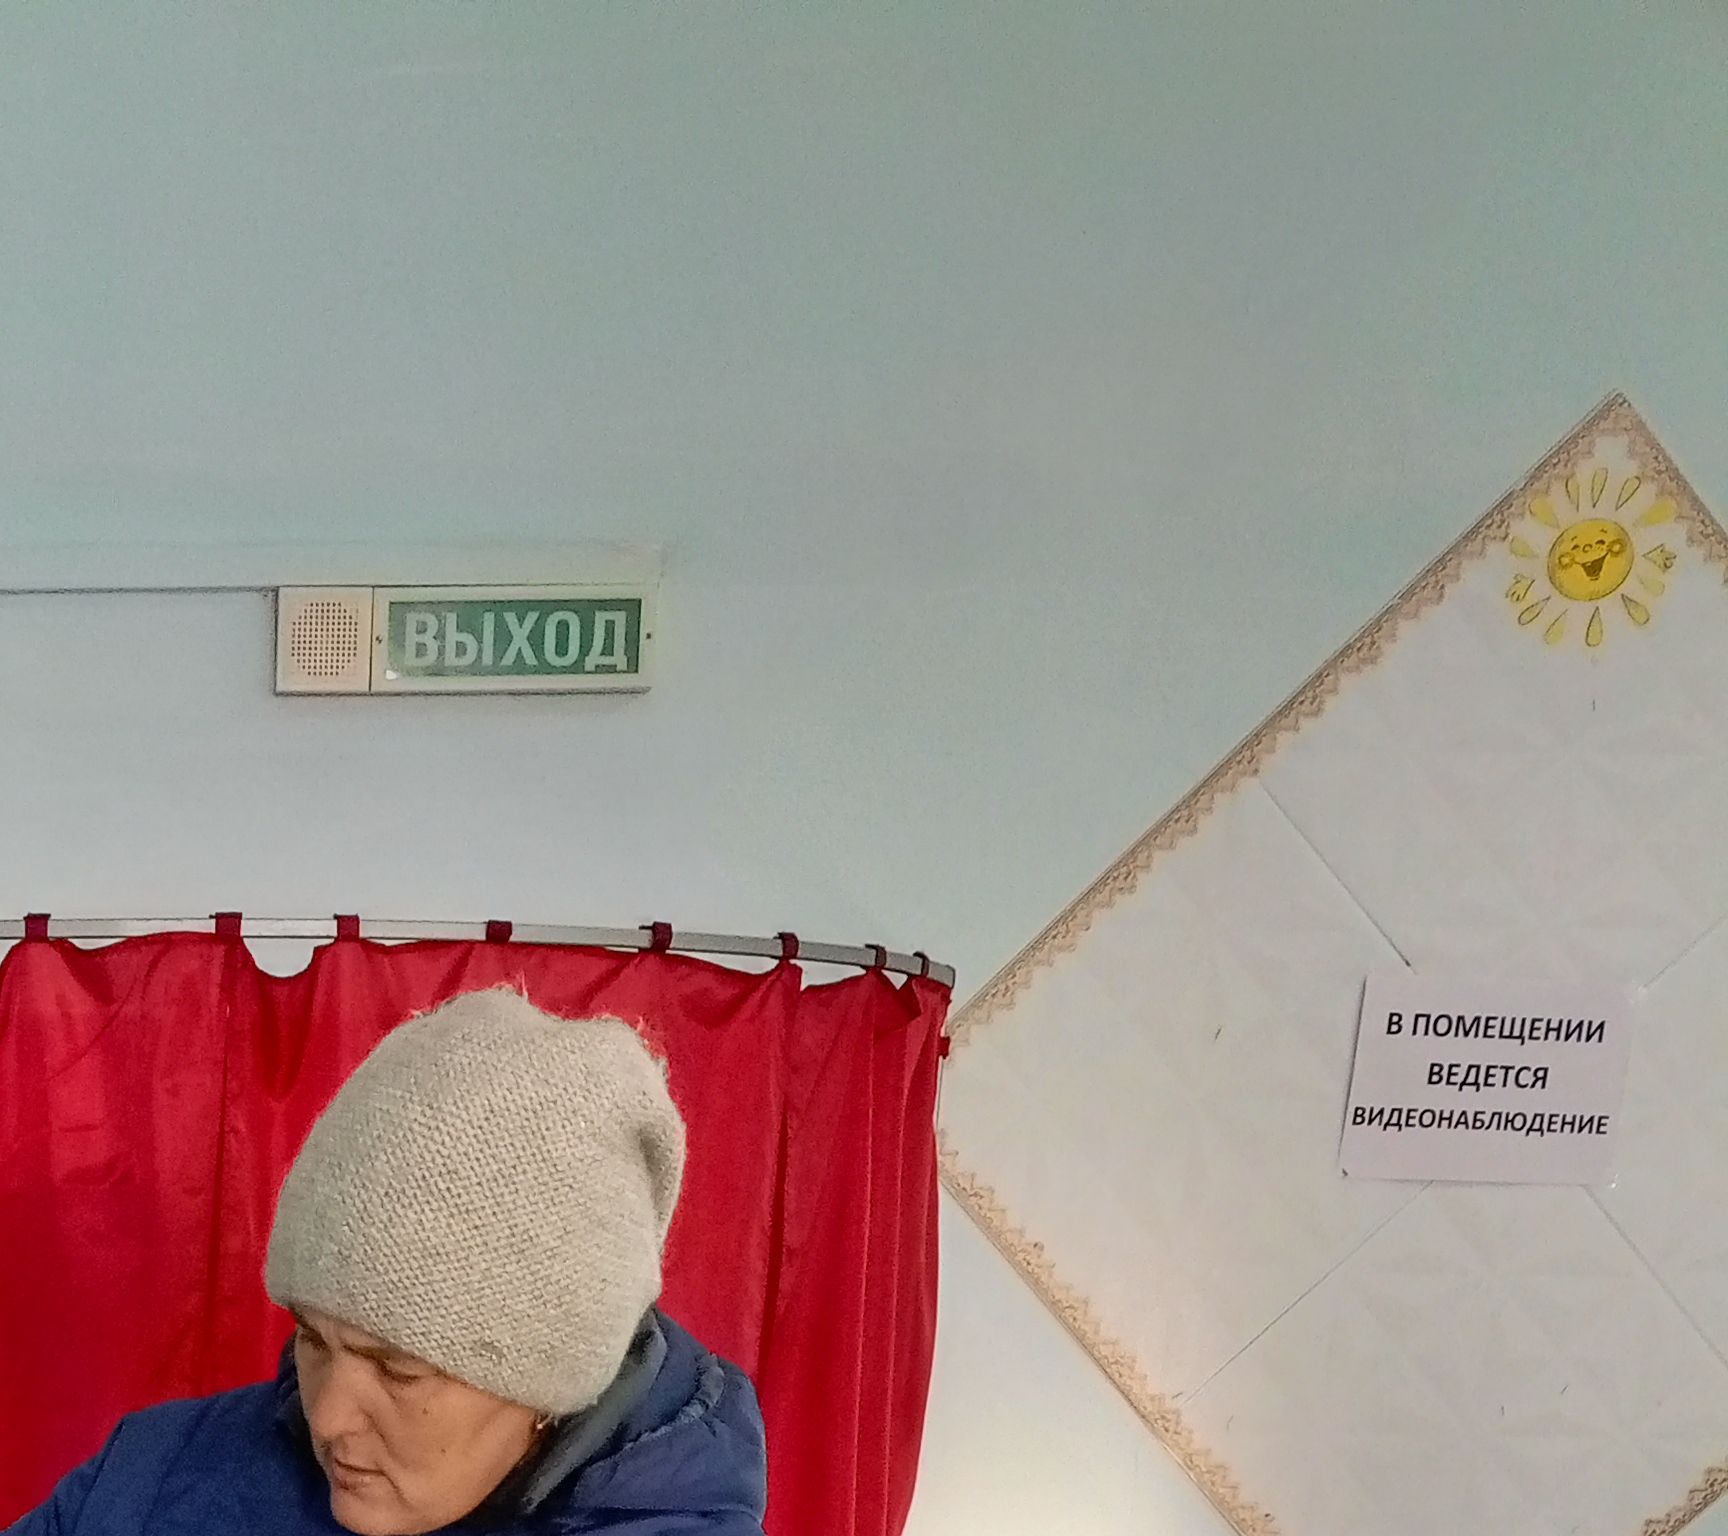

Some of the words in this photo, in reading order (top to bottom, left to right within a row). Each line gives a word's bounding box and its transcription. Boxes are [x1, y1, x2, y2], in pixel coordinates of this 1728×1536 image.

[404, 610, 628, 672] ВЫХОД
[1386, 1012, 1403, 1035] В
[1412, 1012, 1606, 1045] ПОМЕЩЕНИИ
[1427, 1063, 1549, 1092] ВЕДЕТСЯ
[1352, 1106, 1610, 1137] ВИДЕОНАБЛЮДЕНИЕ
